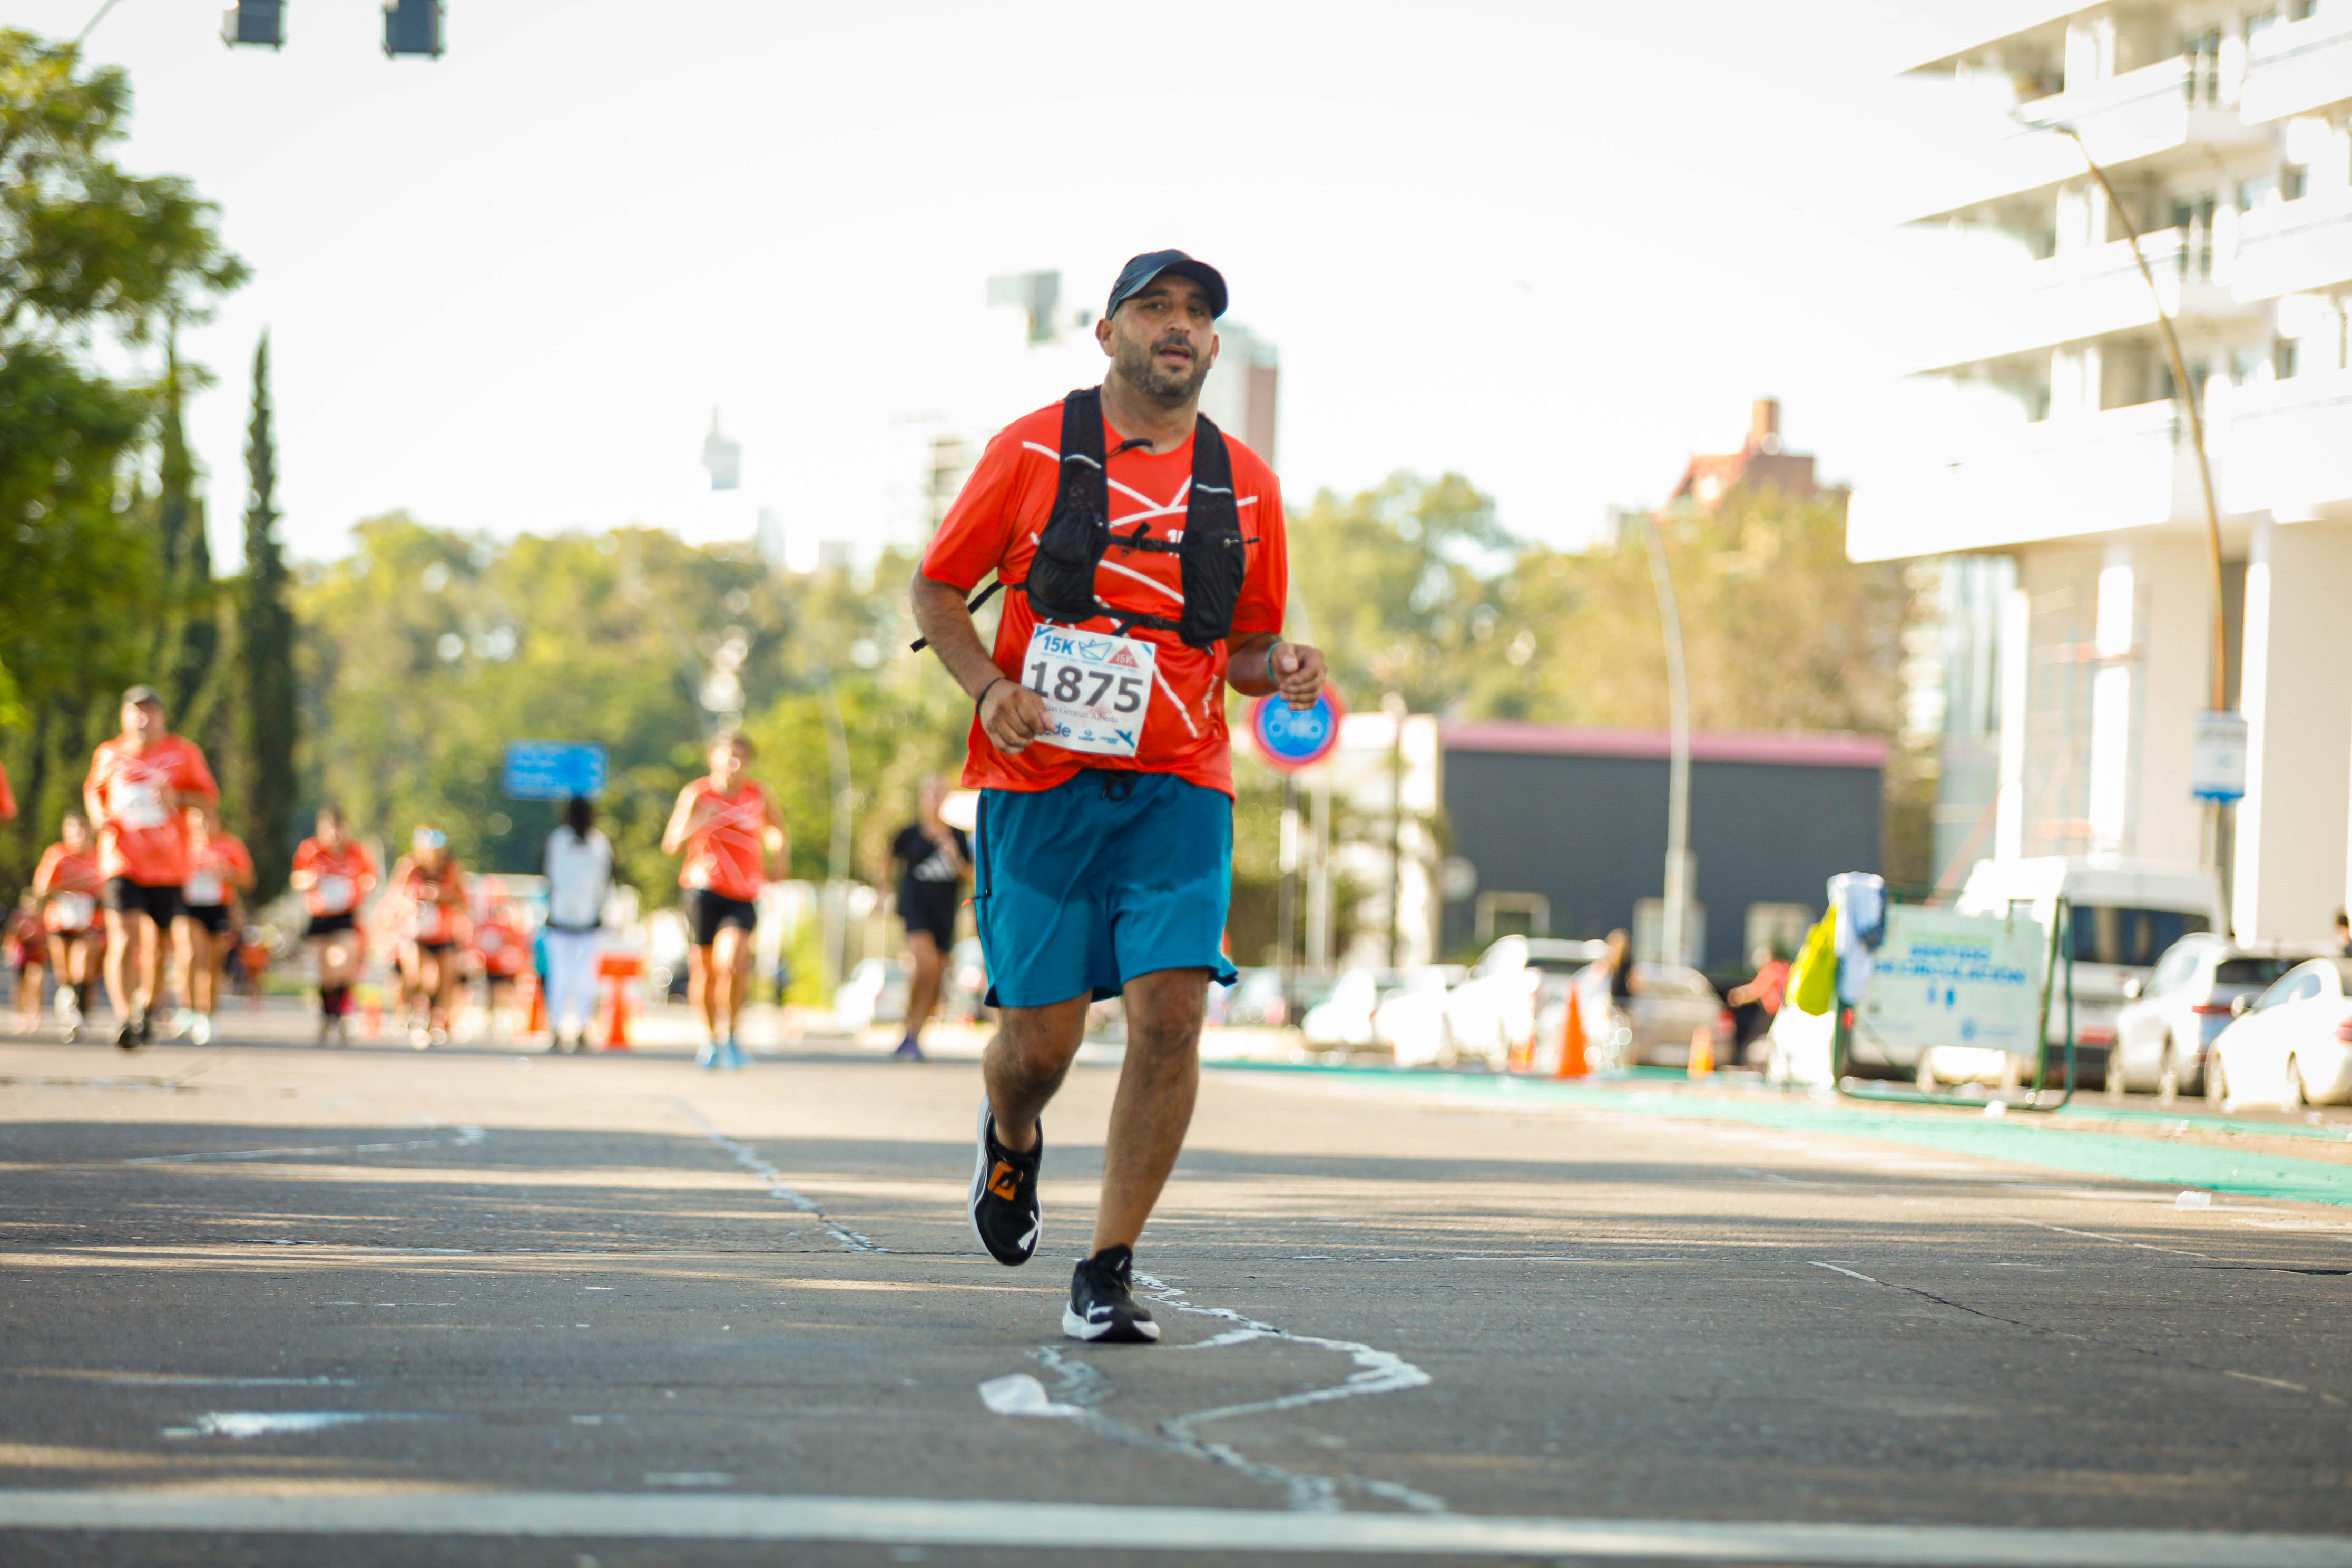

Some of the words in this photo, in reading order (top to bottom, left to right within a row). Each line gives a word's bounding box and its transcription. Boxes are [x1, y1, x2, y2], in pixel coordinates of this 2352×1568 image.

[1044, 635, 1075, 655] 15K
[1116, 652, 1133, 664] 15K
[1031, 661, 1144, 713] 1875
[1091, 711, 1118, 723] Alberto
